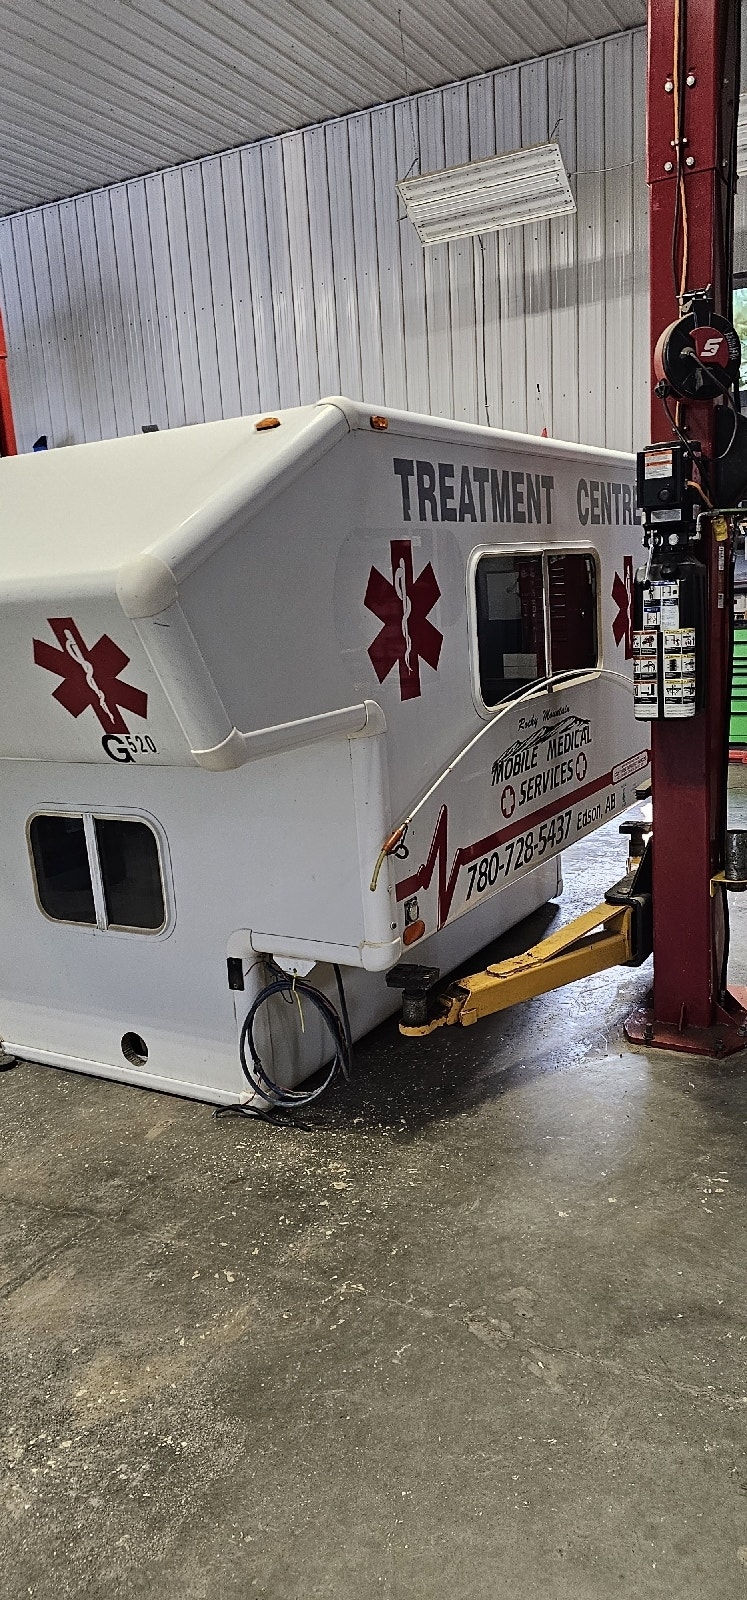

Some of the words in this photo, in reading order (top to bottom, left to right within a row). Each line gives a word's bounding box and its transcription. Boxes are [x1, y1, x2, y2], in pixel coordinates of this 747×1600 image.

[393, 458, 554, 524] TREATMENT
[517, 713, 539, 731] Rocky
[542, 704, 570, 721] Mountain
[491, 746, 539, 786] MOBILE
[547, 725, 593, 762] MEDICAL
[518, 758, 574, 806] SERVICES
[465, 809, 573, 902] 780-728-5437
[576, 803, 603, 831] Edson,
[604, 792, 616, 814] AB
